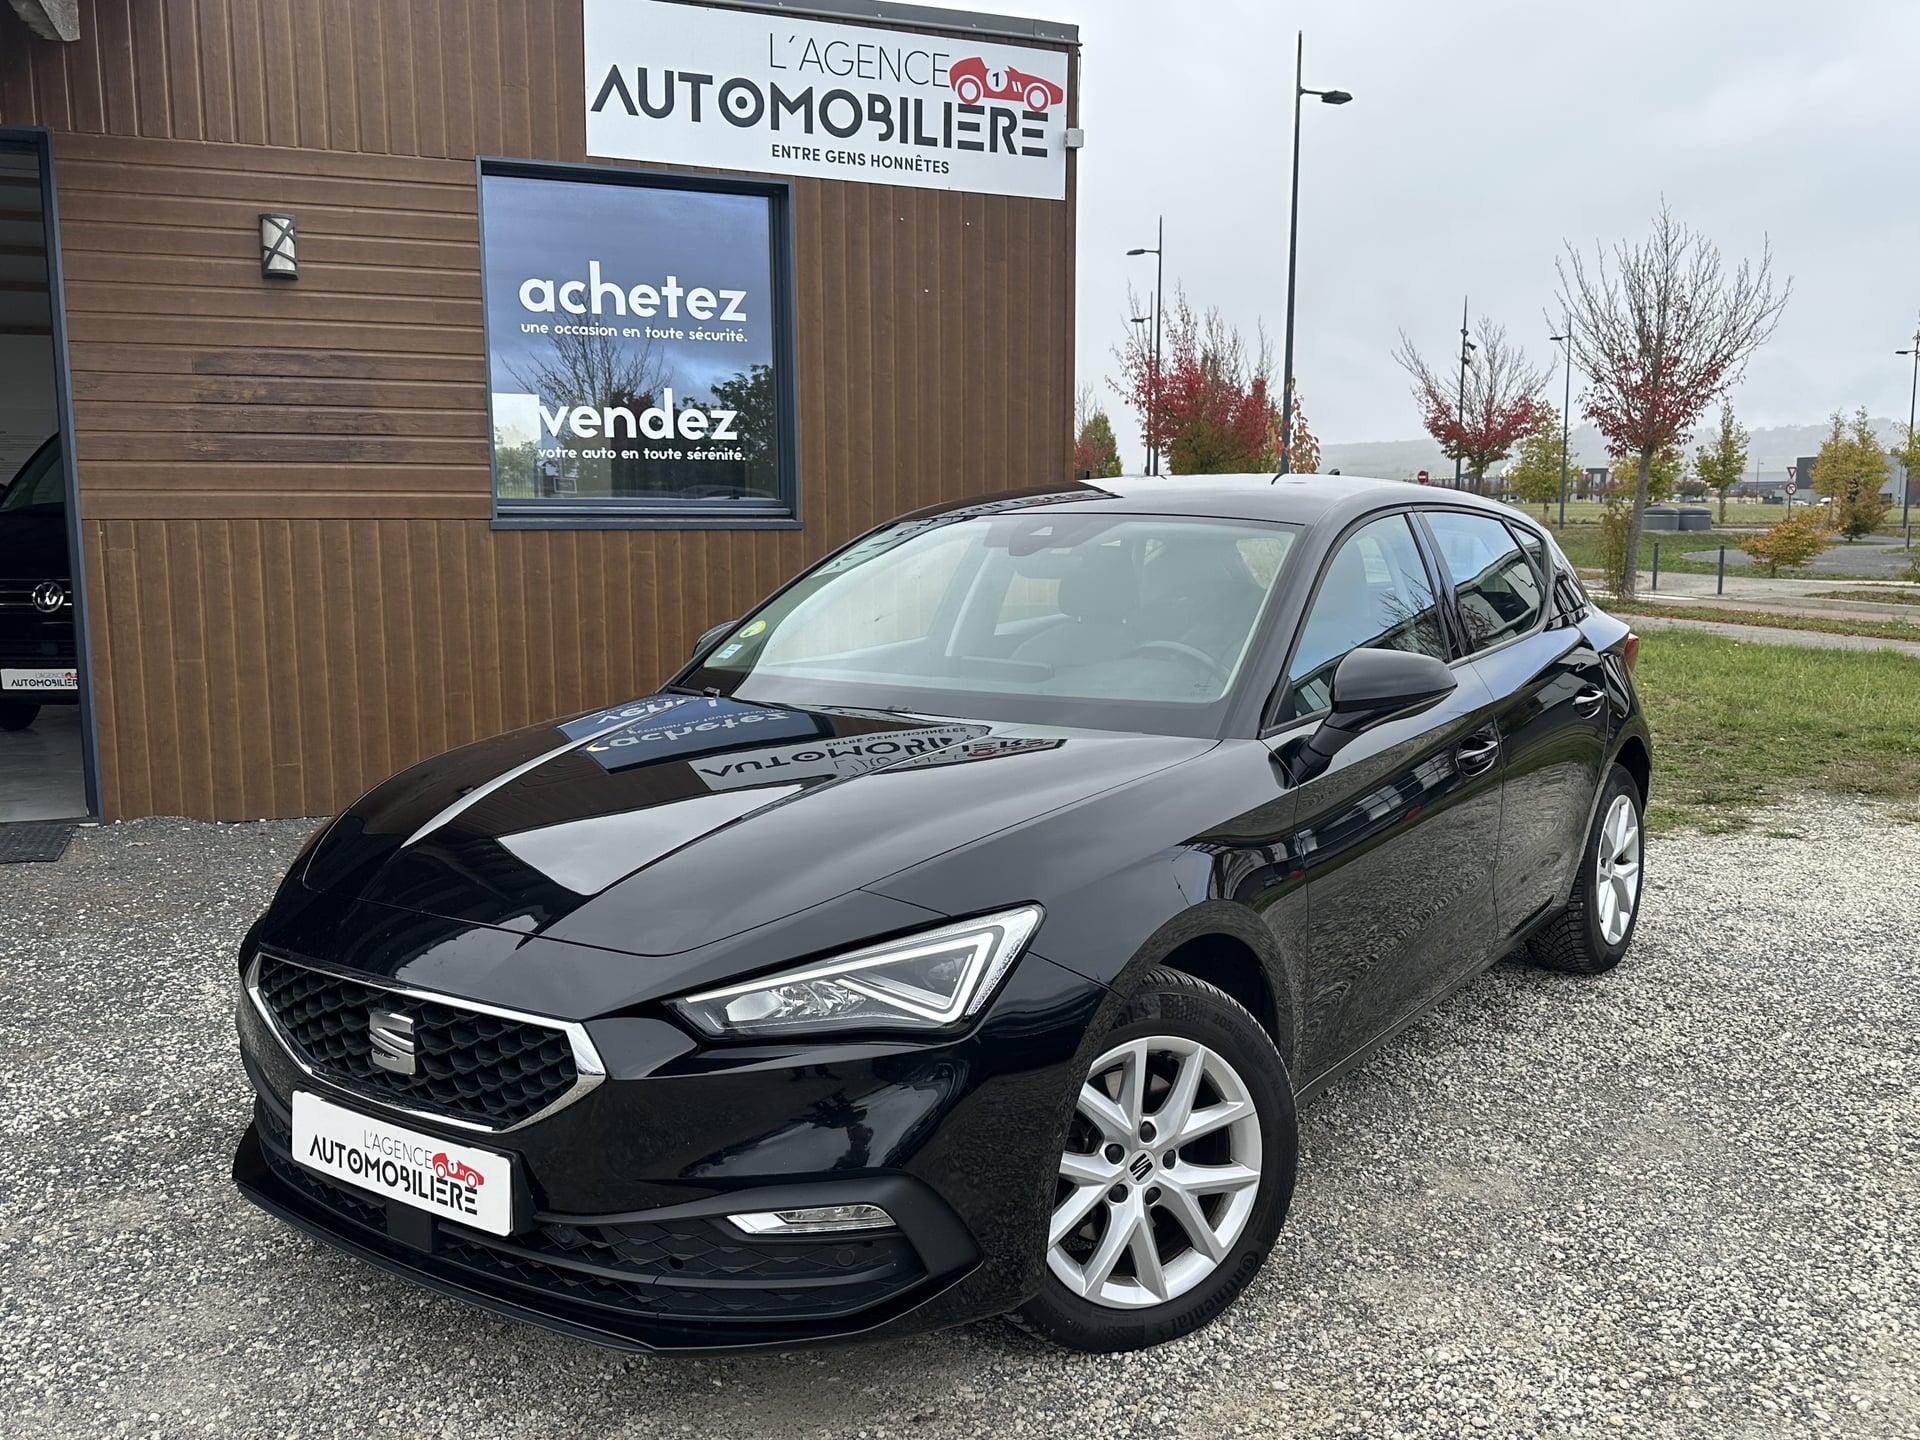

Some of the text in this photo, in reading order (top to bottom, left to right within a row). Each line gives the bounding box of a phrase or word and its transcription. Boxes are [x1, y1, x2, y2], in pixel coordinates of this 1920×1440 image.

[769, 33, 950, 88] L'AGENCE
[590, 64, 1049, 158] AUTOMOBILIERE
[772, 144, 950, 174] ENTRE GENS HONNÊTES
[518, 260, 747, 322] achetez
[521, 322, 748, 343] une occasion en toute sécurité.
[539, 387, 738, 441] vendez
[538, 447, 747, 461] votre auto en toute sérénité.
[309, 1134, 478, 1216] AUTOMOBILIERE
[363, 1129, 433, 1170] L'AGENCE
